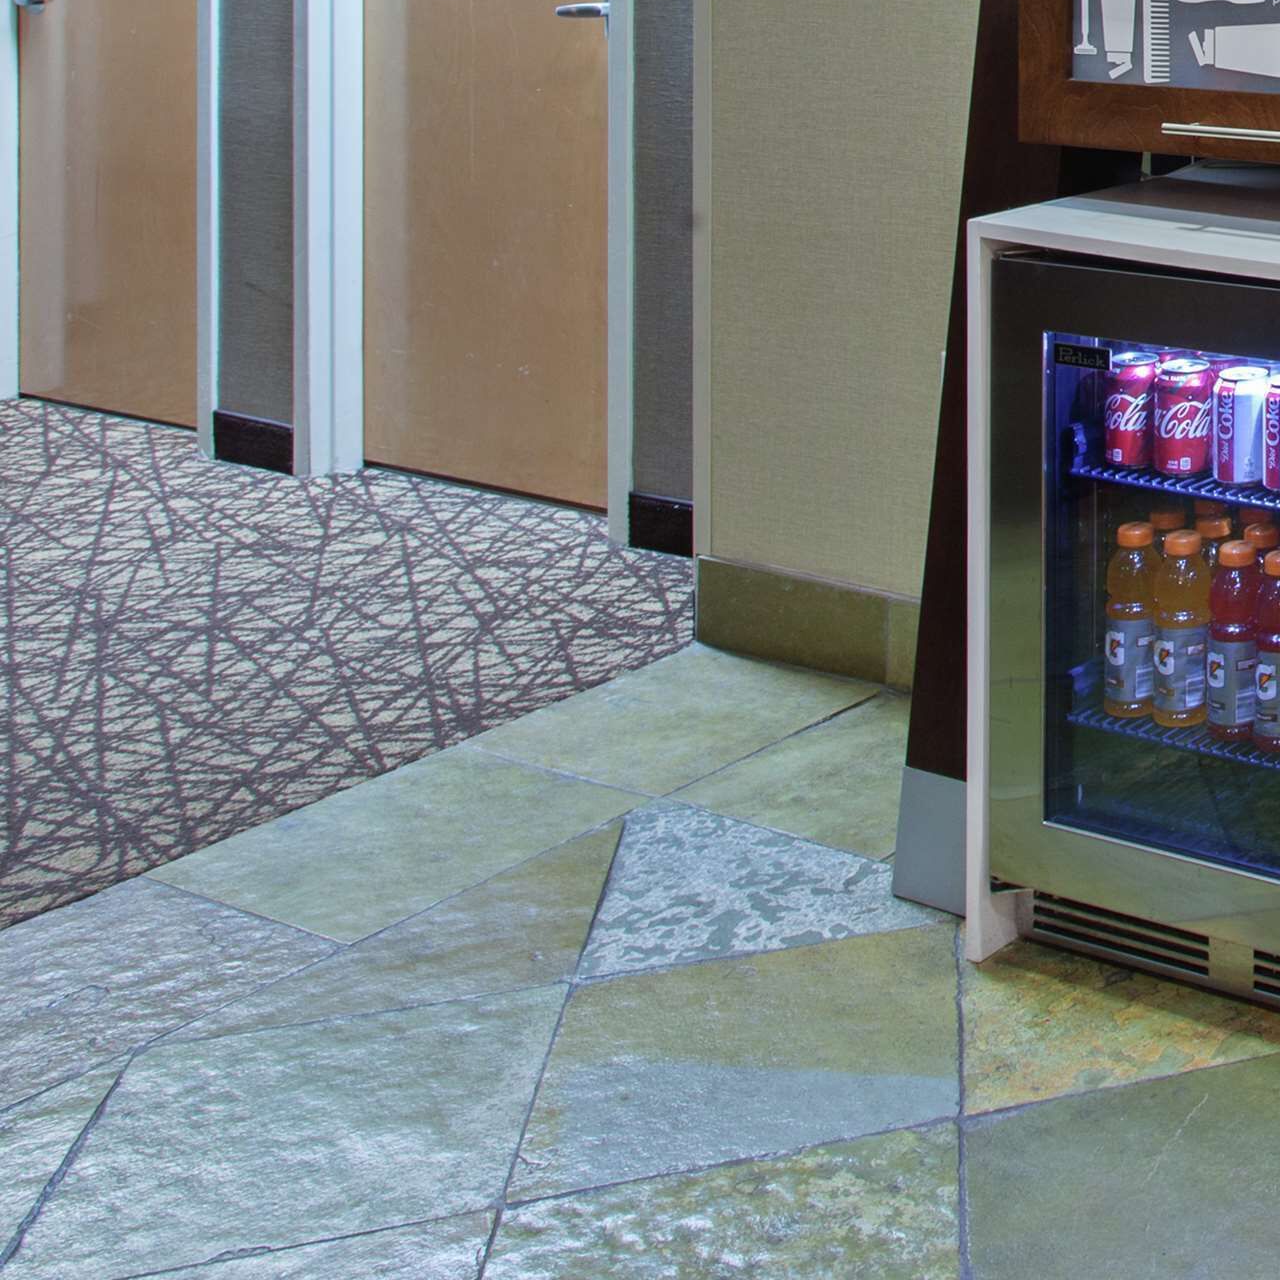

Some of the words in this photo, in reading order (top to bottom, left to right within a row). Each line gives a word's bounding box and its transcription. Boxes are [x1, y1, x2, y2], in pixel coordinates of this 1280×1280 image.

[1058, 347, 1105, 367] Perlick
[1218, 390, 1233, 440] Coke
[1266, 396, 1280, 447] Coke
